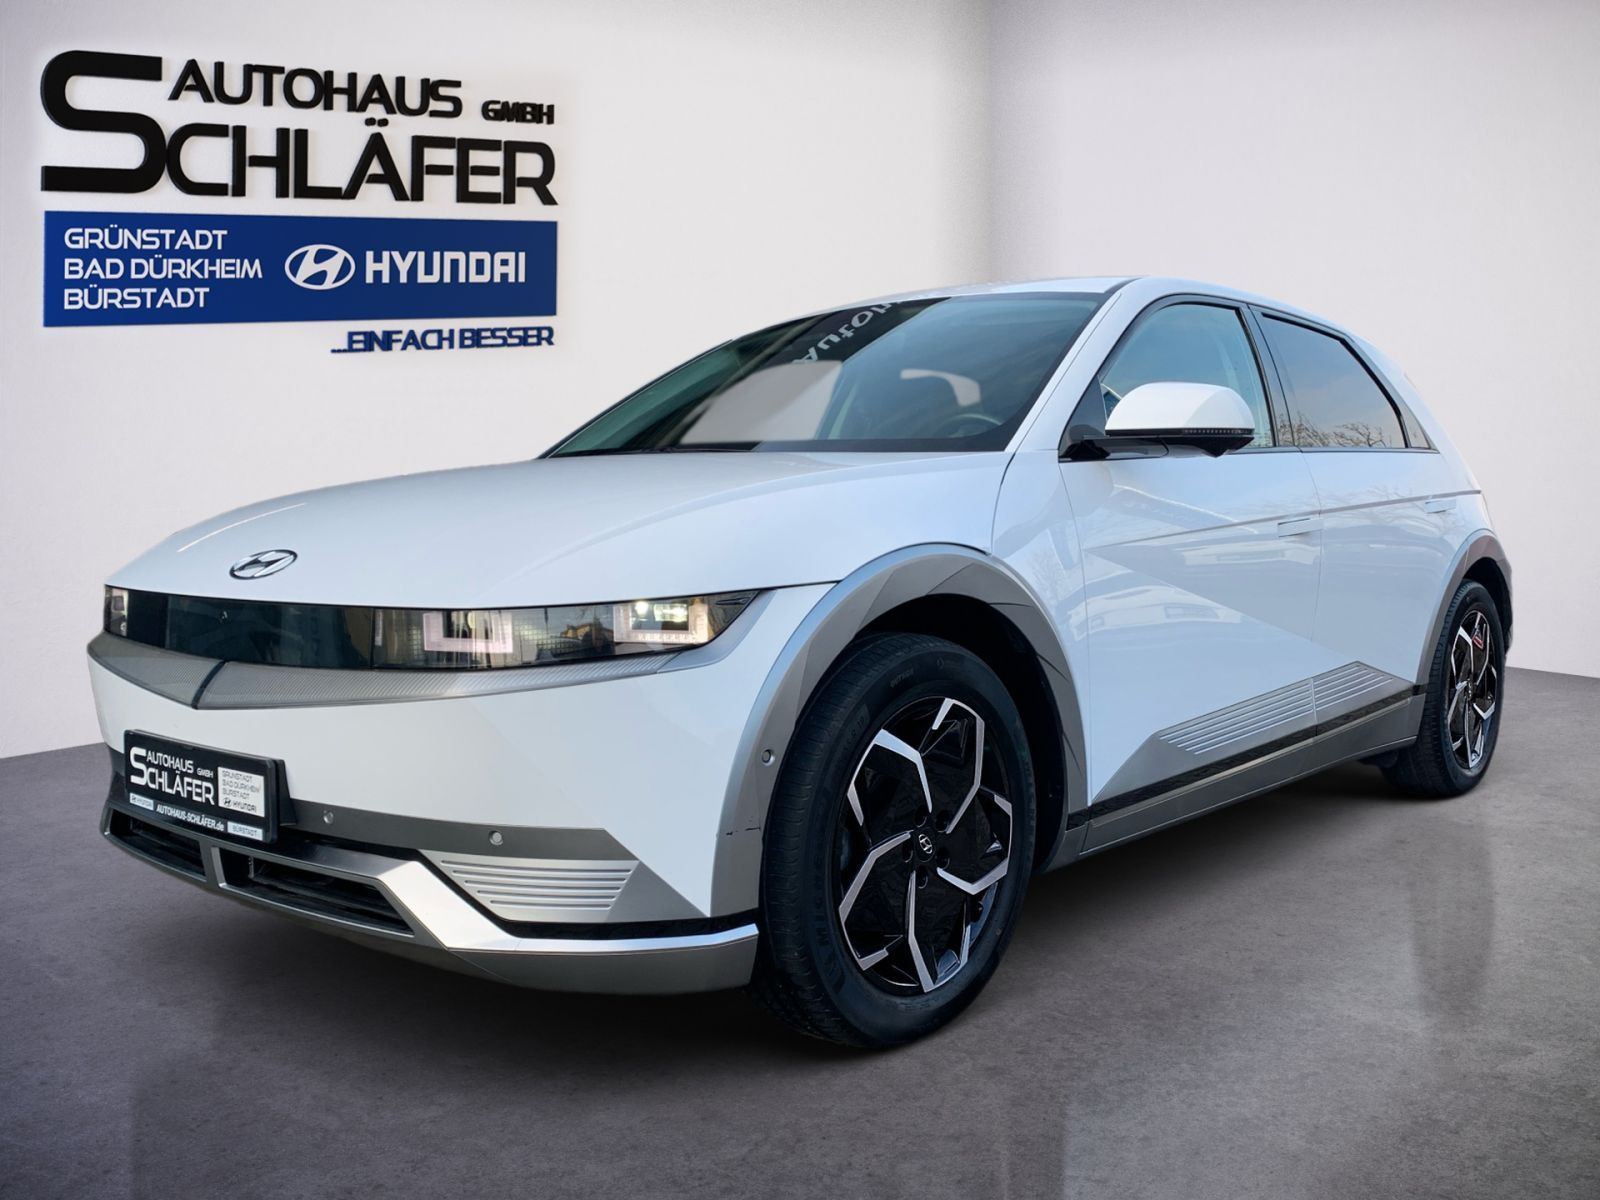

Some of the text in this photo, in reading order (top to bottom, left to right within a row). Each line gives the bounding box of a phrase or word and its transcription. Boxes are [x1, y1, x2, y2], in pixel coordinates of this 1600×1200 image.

[168, 59, 554, 124] AUTOHAUS GMBH
[40, 50, 558, 205] SCHLÄFER
[64, 225, 227, 250] GRÜNSTADT
[64, 254, 262, 280] BAD DÜRKHEIM
[365, 251, 526, 284] HYUNDAI
[64, 284, 210, 309] BÜRSTADT
[459, 326, 554, 349] BESSER
[147, 751, 193, 773] AUTOHAUS
[130, 746, 215, 805] SCHLÄFER
